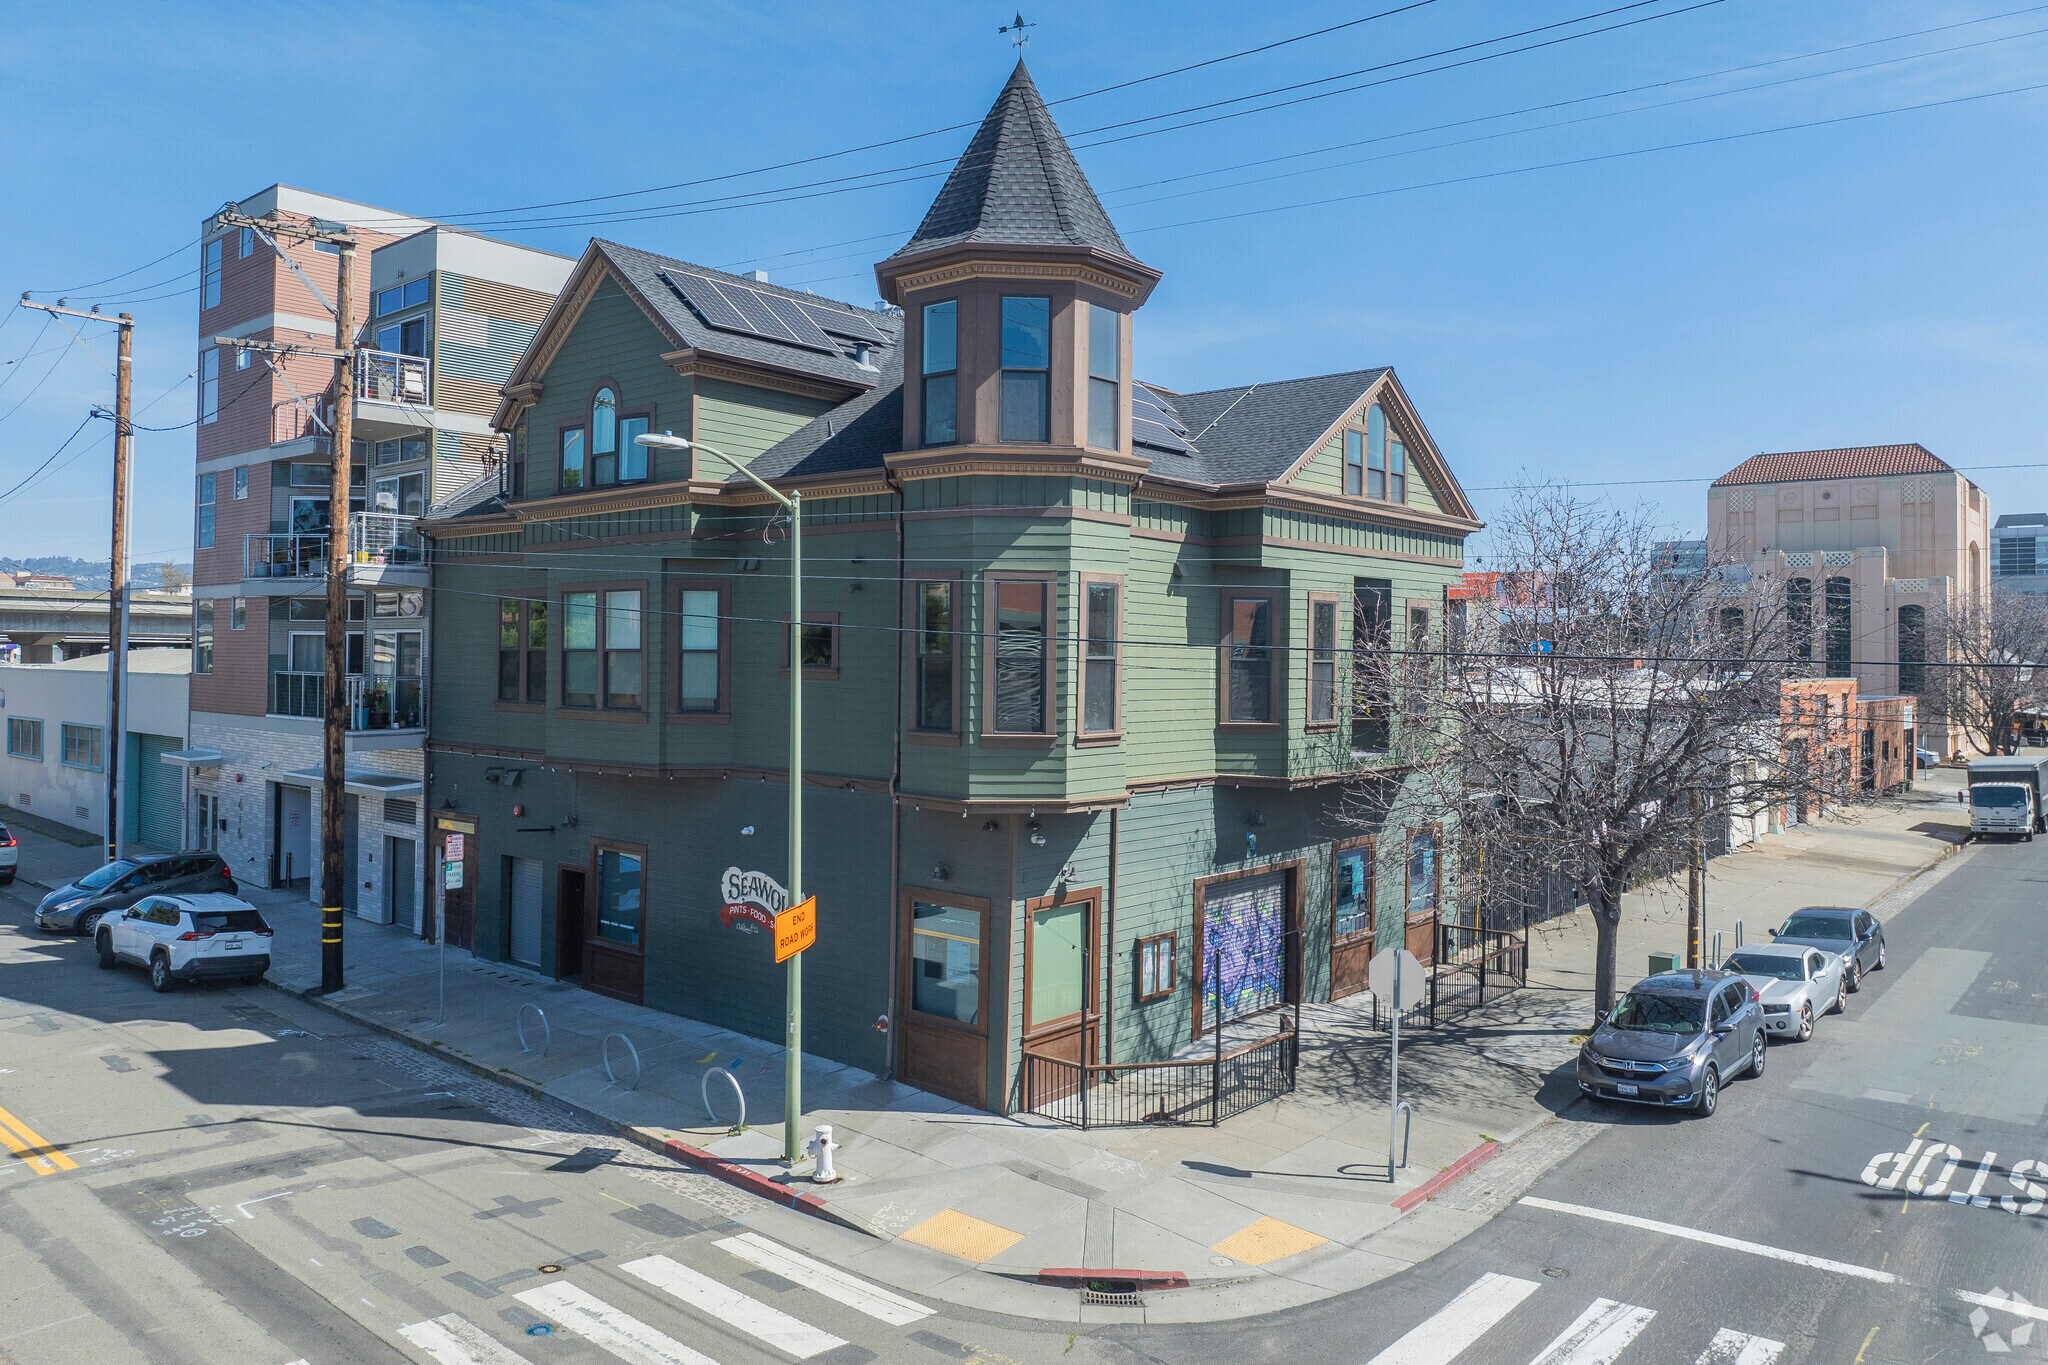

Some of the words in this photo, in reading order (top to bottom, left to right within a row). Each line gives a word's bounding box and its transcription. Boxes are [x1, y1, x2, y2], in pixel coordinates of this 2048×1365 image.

[728, 873, 787, 912] SEAWOL
[729, 905, 747, 915] PINTS
[750, 909, 767, 923] FOOD
[792, 911, 806, 926] END
[780, 932, 799, 949] ROAD
[800, 923, 814, 940] WORK
[1860, 1138, 2048, 1216] STOP
